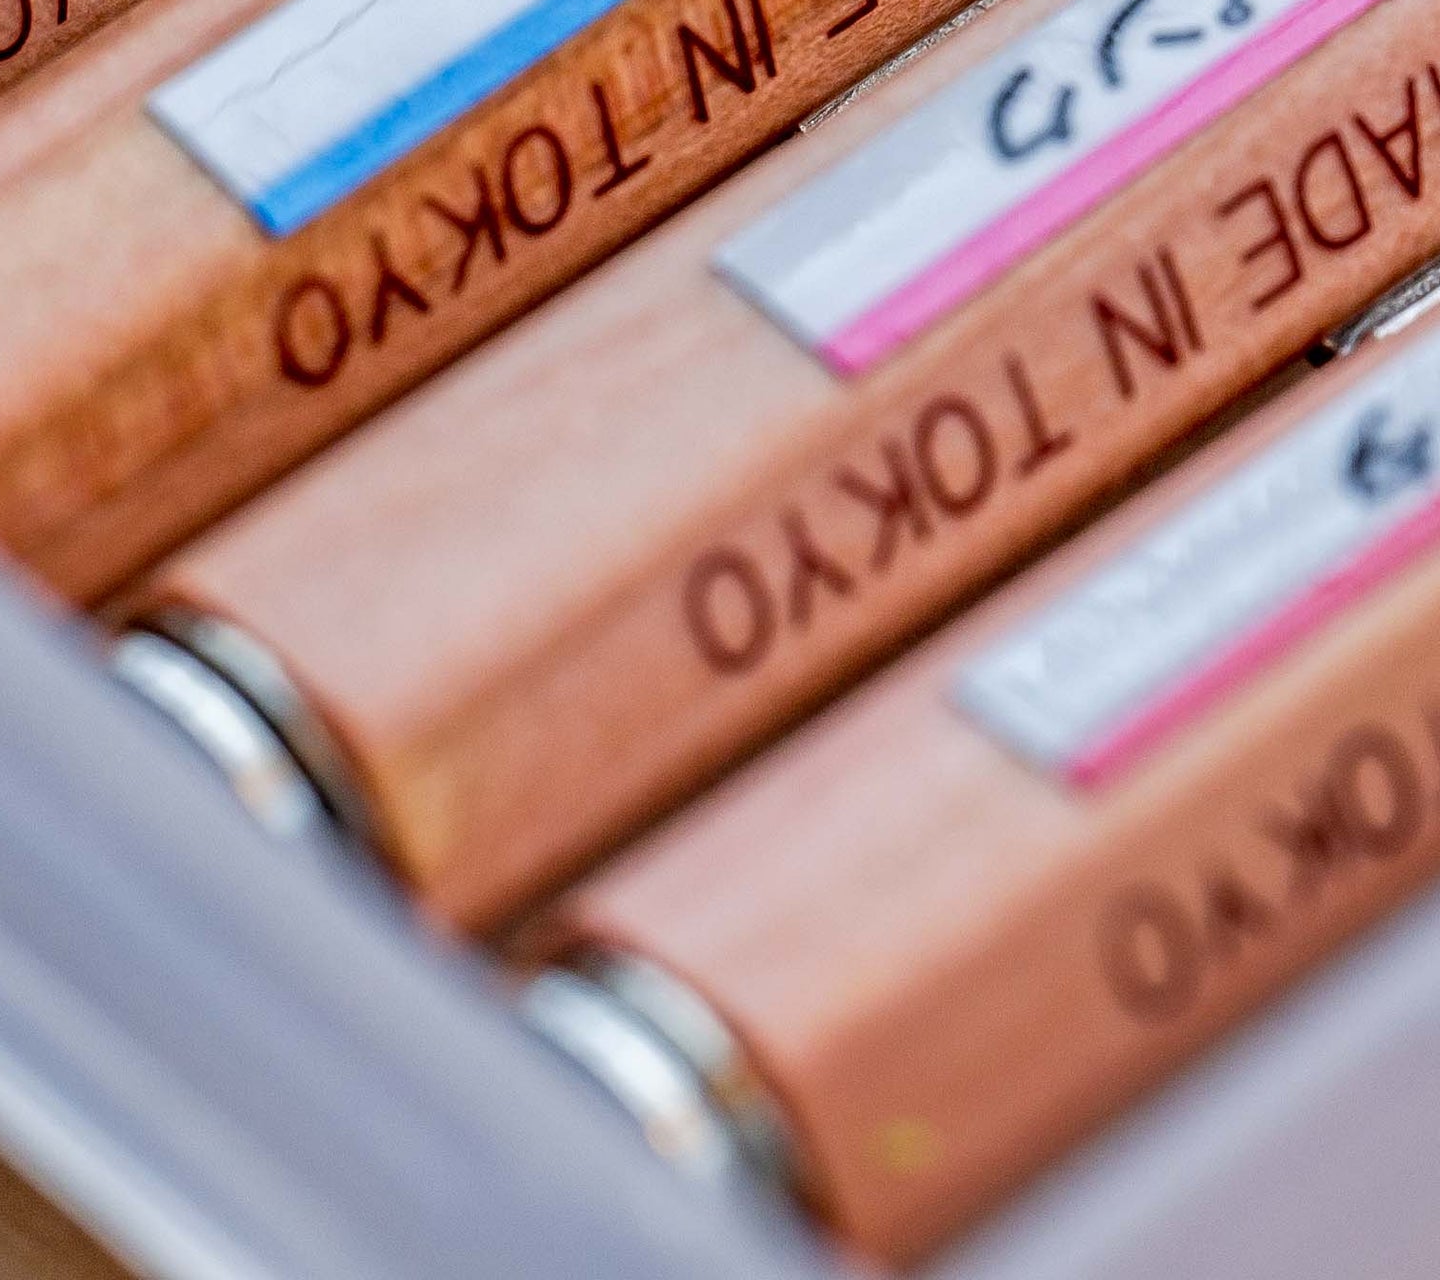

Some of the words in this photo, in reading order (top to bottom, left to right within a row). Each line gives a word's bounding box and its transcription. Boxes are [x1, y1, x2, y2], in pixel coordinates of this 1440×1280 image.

[272, 82, 647, 395] TOKYO
[1090, 248, 1196, 400] IN
[682, 356, 1072, 680] TOKYO
